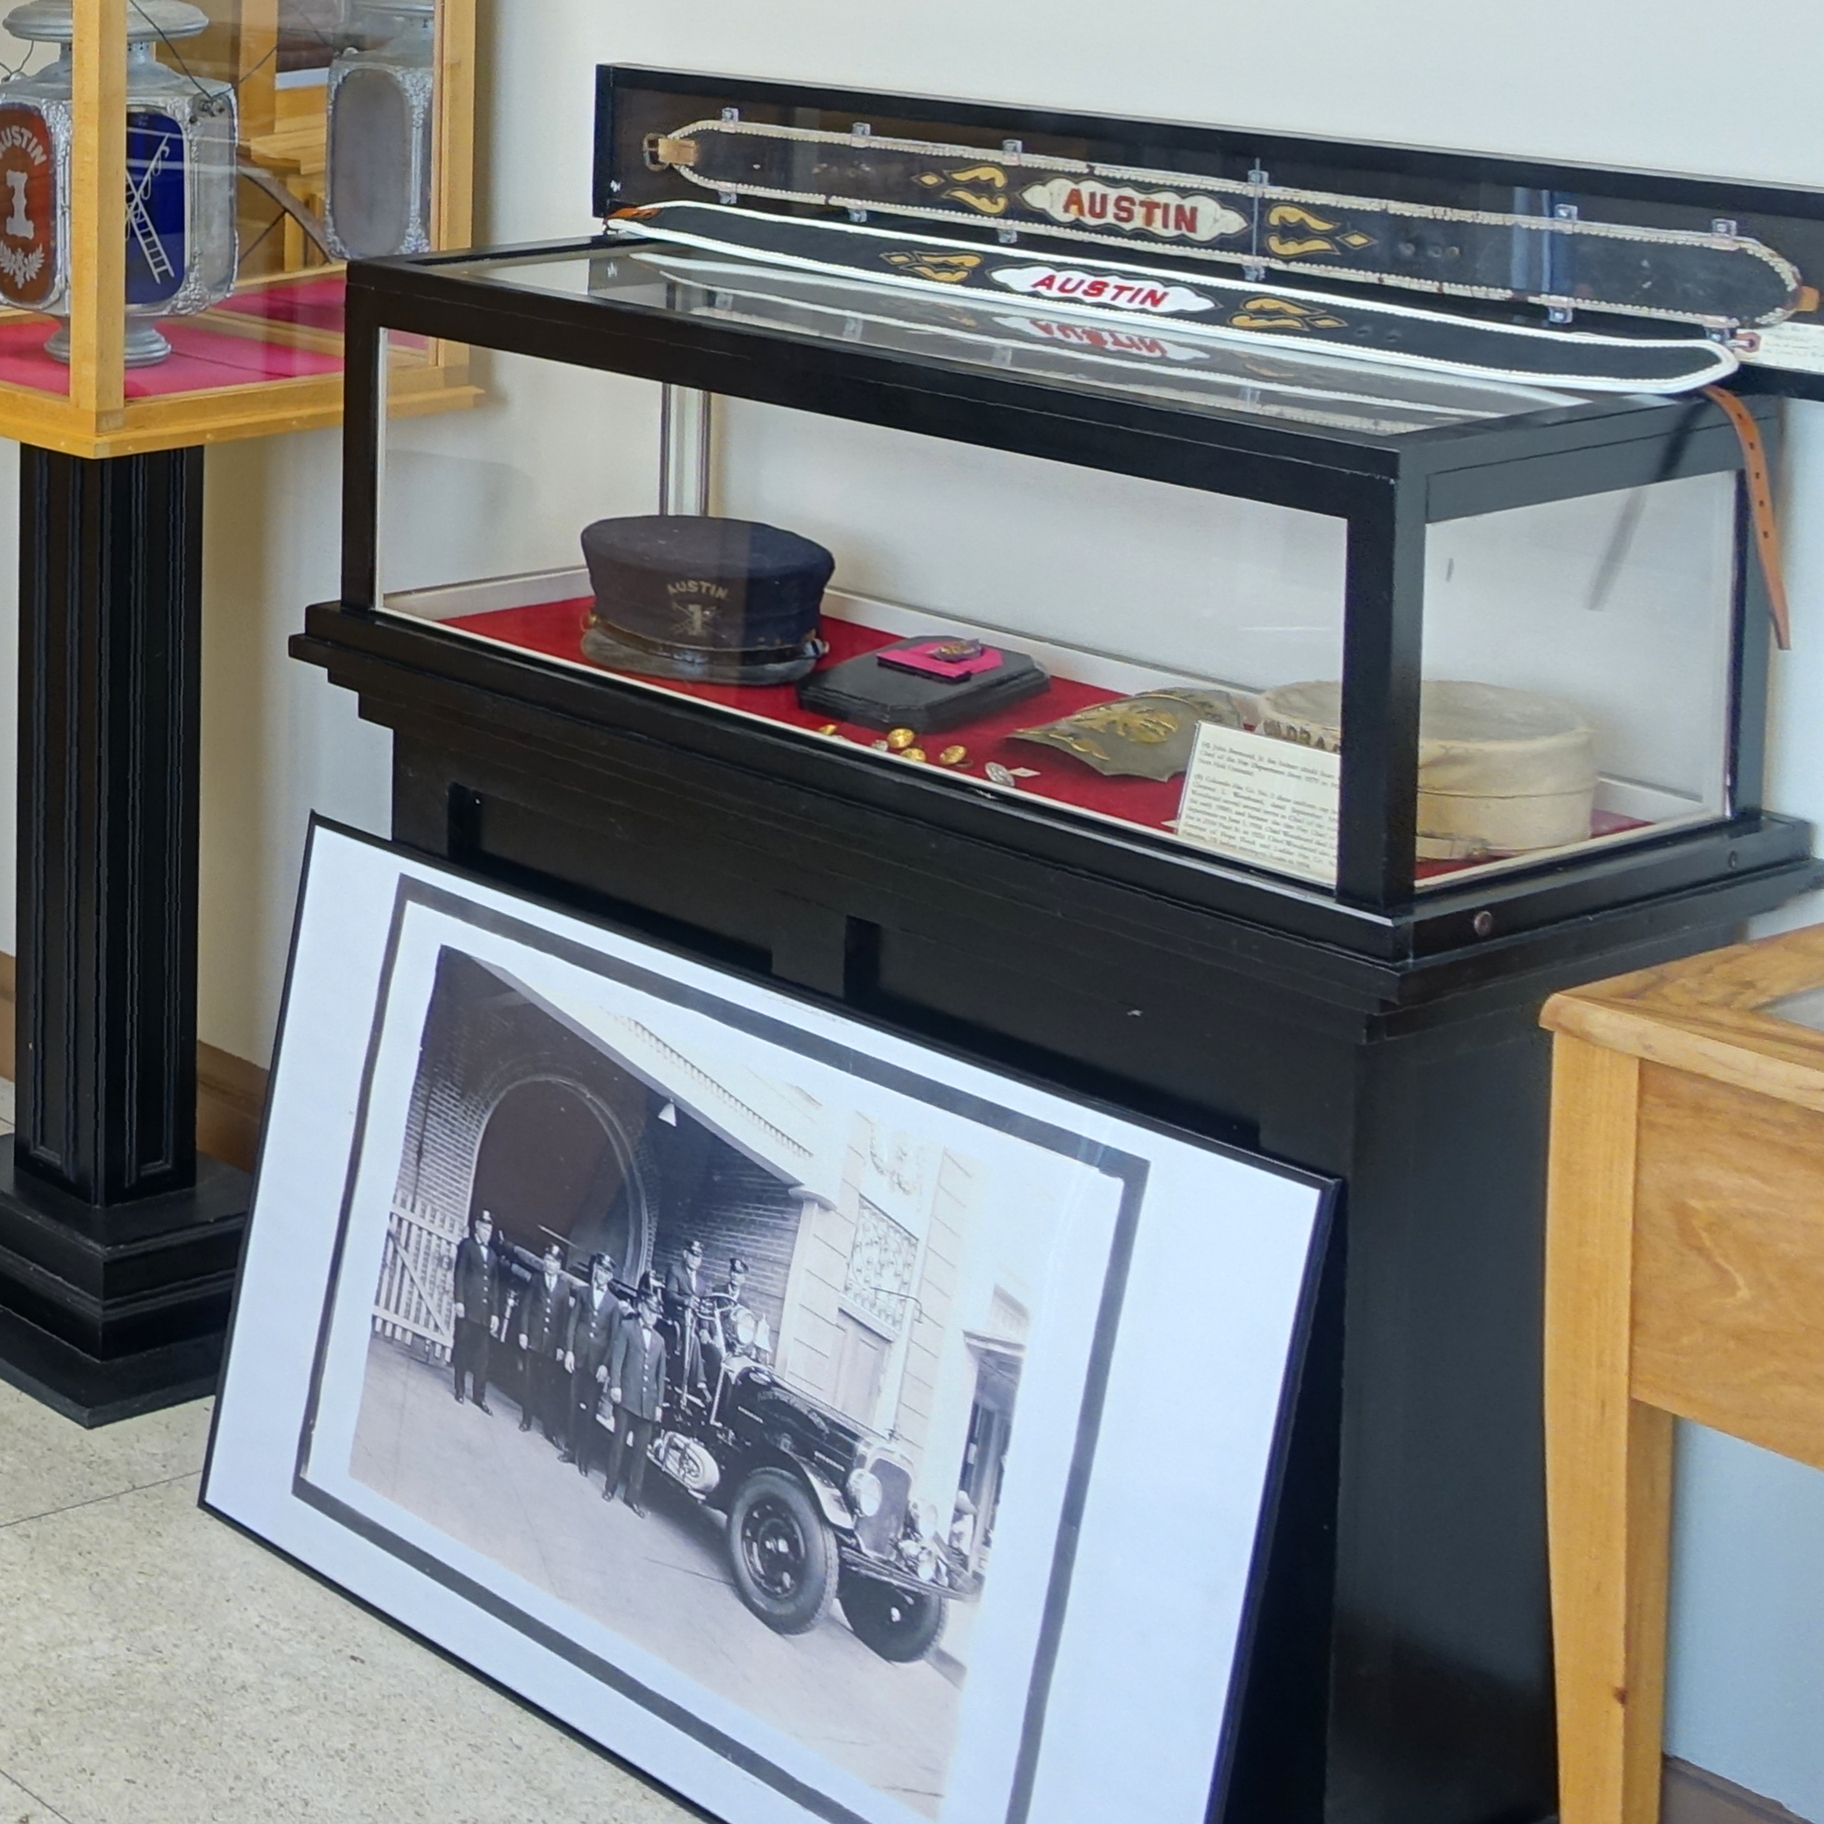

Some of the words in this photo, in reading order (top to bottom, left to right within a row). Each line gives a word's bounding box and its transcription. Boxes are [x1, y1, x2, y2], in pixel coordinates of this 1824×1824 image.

[6, 169, 34, 240] 1
[1062, 188, 1198, 233] AUSTIN
[1031, 274, 1169, 308] AUSTIN
[666, 580, 729, 599] AUSTIN
